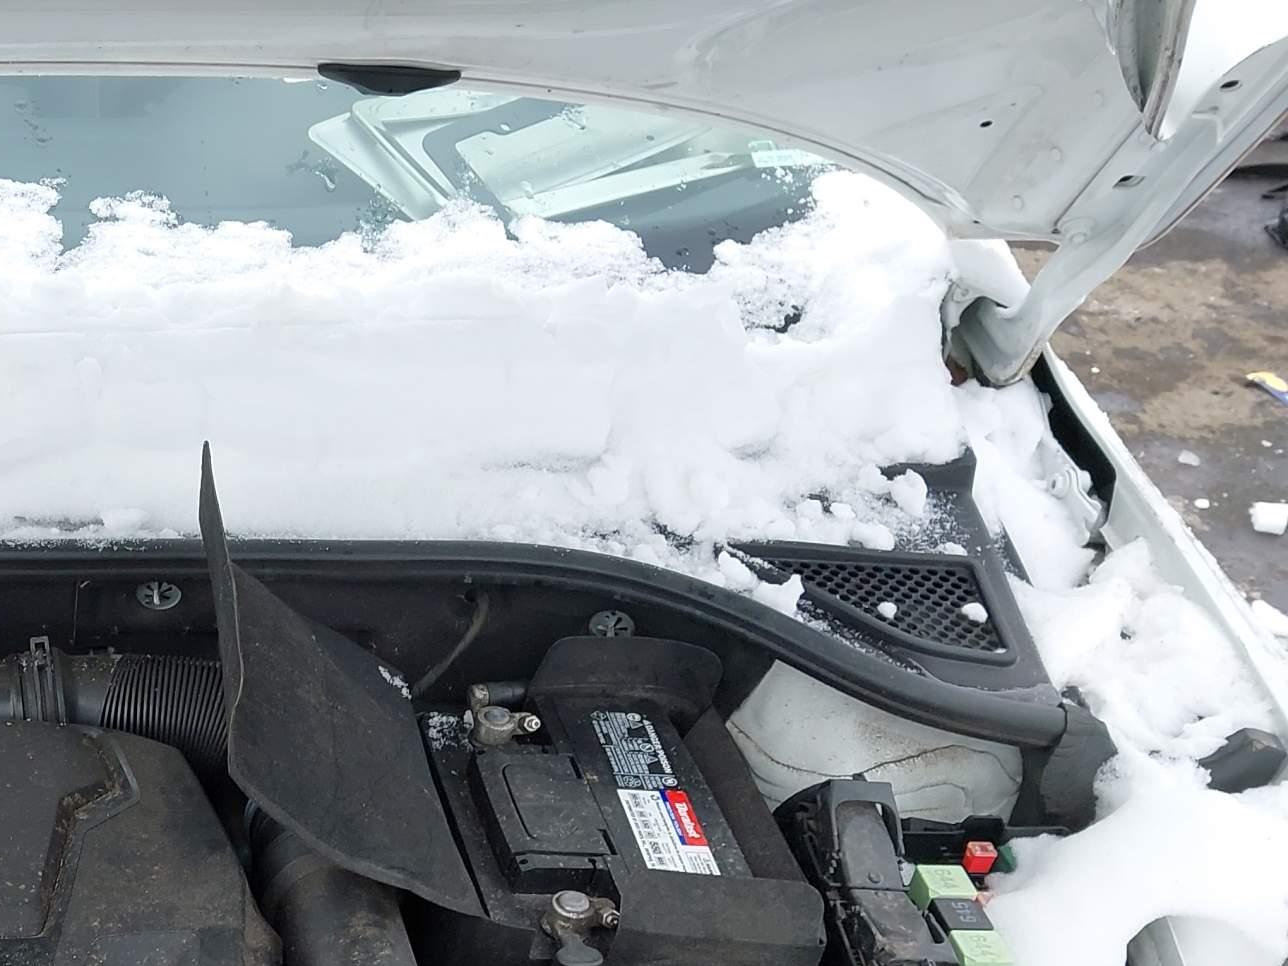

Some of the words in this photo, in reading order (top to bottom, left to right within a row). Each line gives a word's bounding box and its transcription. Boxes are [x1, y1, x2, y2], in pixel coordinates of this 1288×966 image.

[646, 725, 664, 752] DANGER
[657, 749, 673, 774] POISON
[674, 802, 701, 839] Duralast
